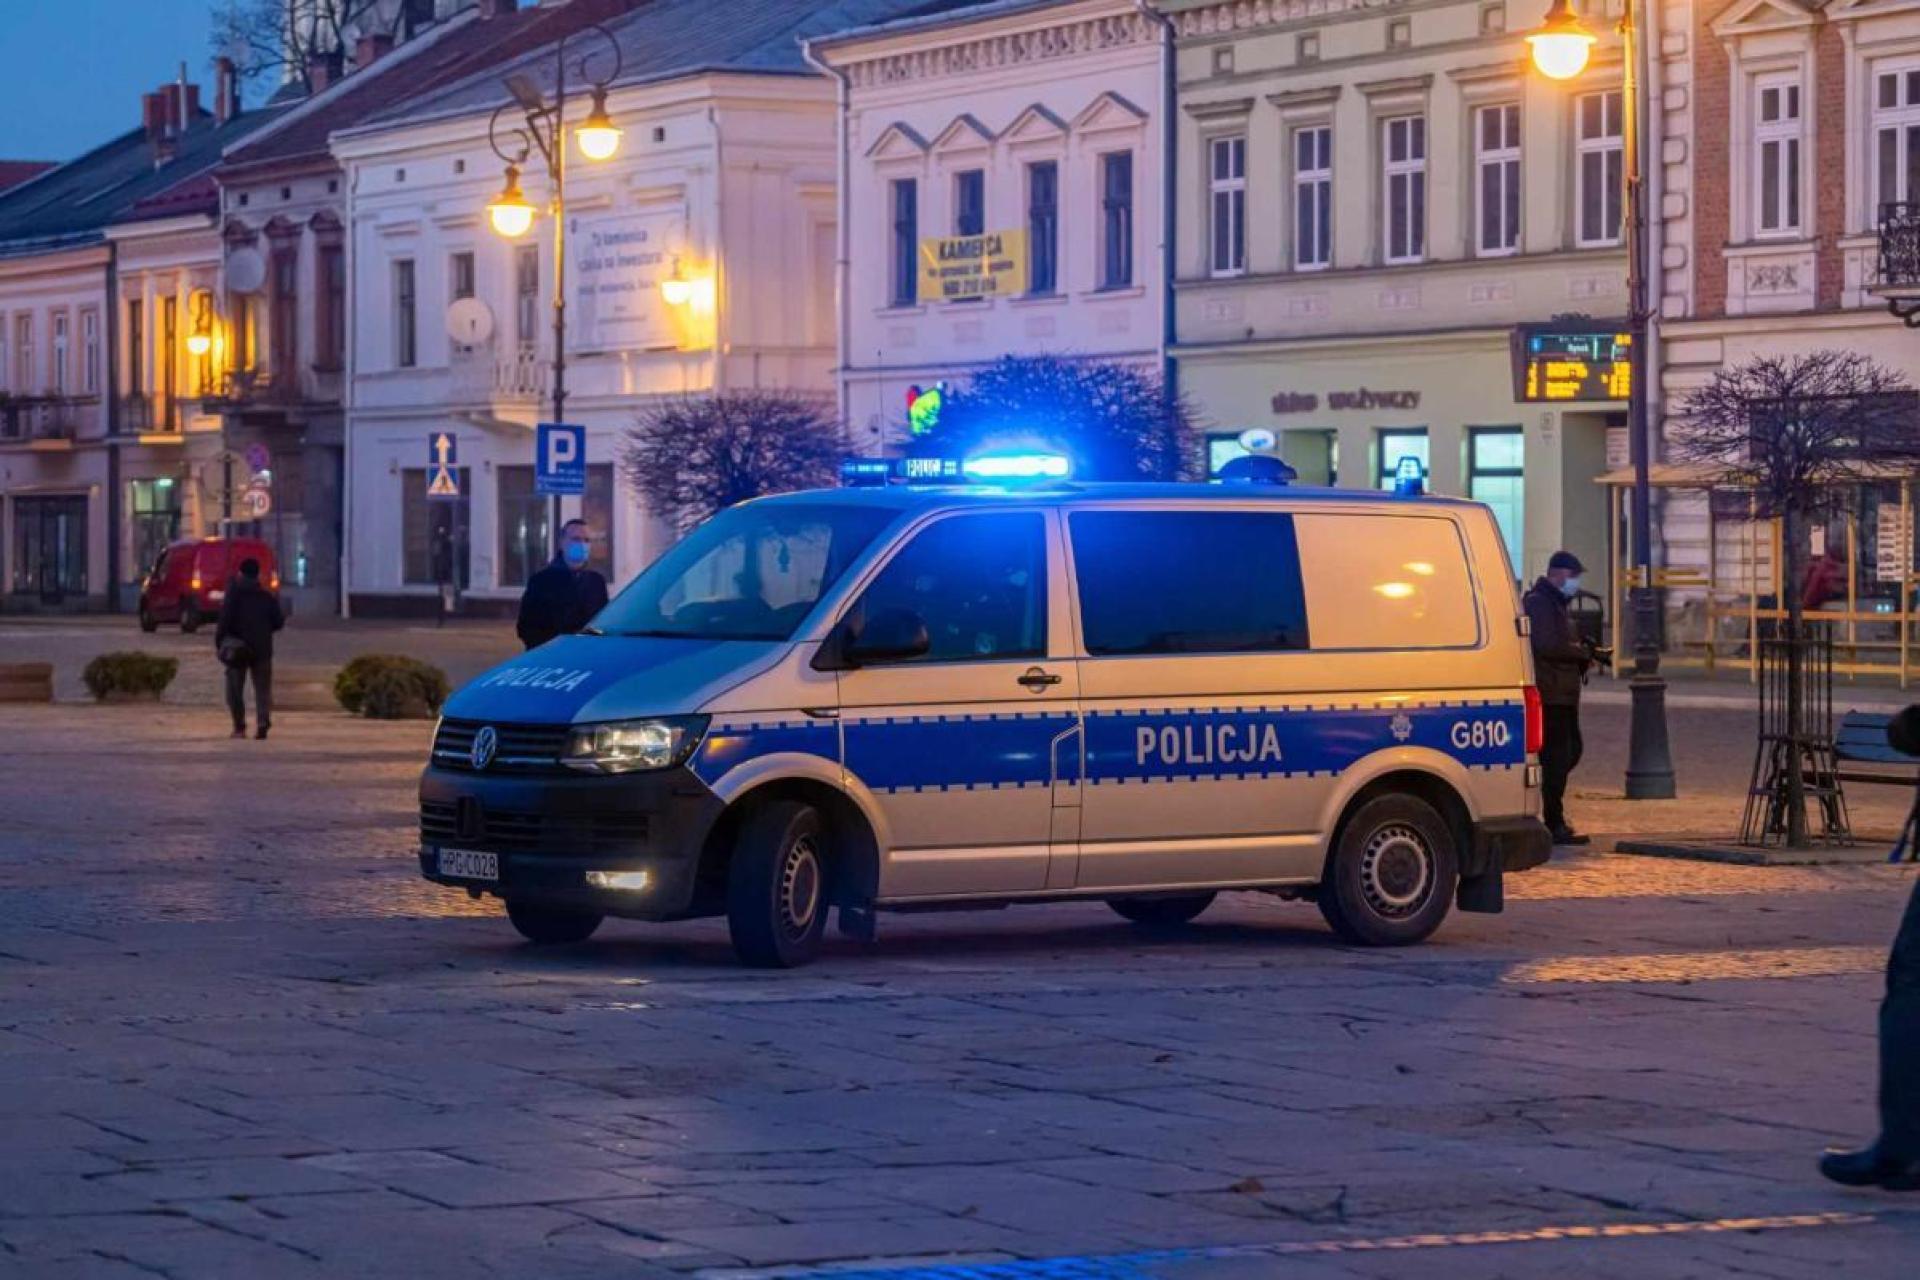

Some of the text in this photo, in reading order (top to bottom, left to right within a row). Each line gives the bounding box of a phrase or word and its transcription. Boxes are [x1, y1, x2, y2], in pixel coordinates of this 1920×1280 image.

[548, 430, 576, 474] P
[480, 666, 593, 693] POLICJA
[1136, 723, 1282, 765] POLICJA
[1450, 719, 1508, 749] G810
[466, 853, 496, 877] C028
